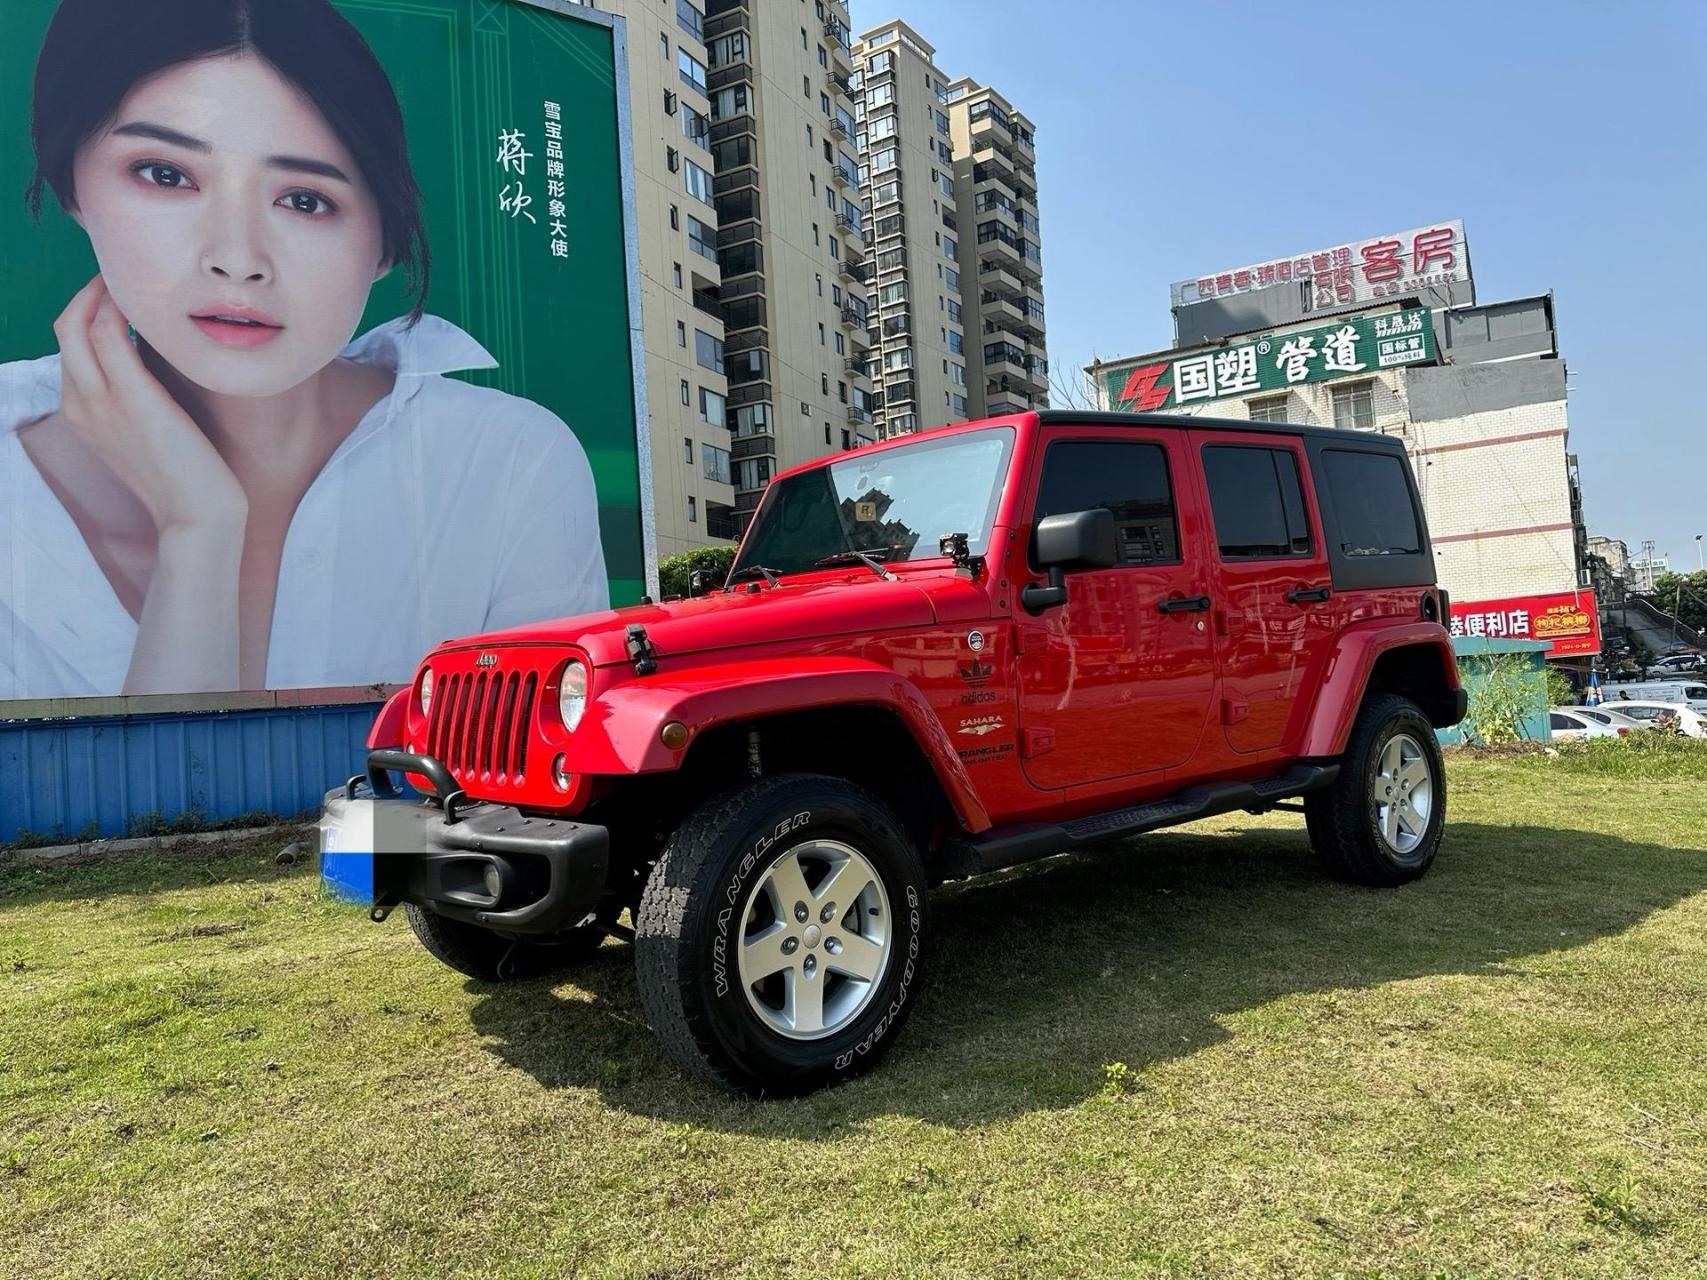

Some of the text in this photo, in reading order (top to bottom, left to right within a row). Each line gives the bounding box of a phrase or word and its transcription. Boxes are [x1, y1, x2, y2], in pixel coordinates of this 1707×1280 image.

[496, 128, 536, 224] 蒋欣
[544, 101, 568, 258] 雪宝品牌形象大使
[1361, 228, 1454, 283] 客房
[1381, 337, 1420, 355] 国标管
[960, 690, 996, 704] adidas
[960, 715, 1003, 727] SAHARA
[713, 811, 810, 998] WRANGLER
[834, 885, 919, 1069] GOODYEAR
